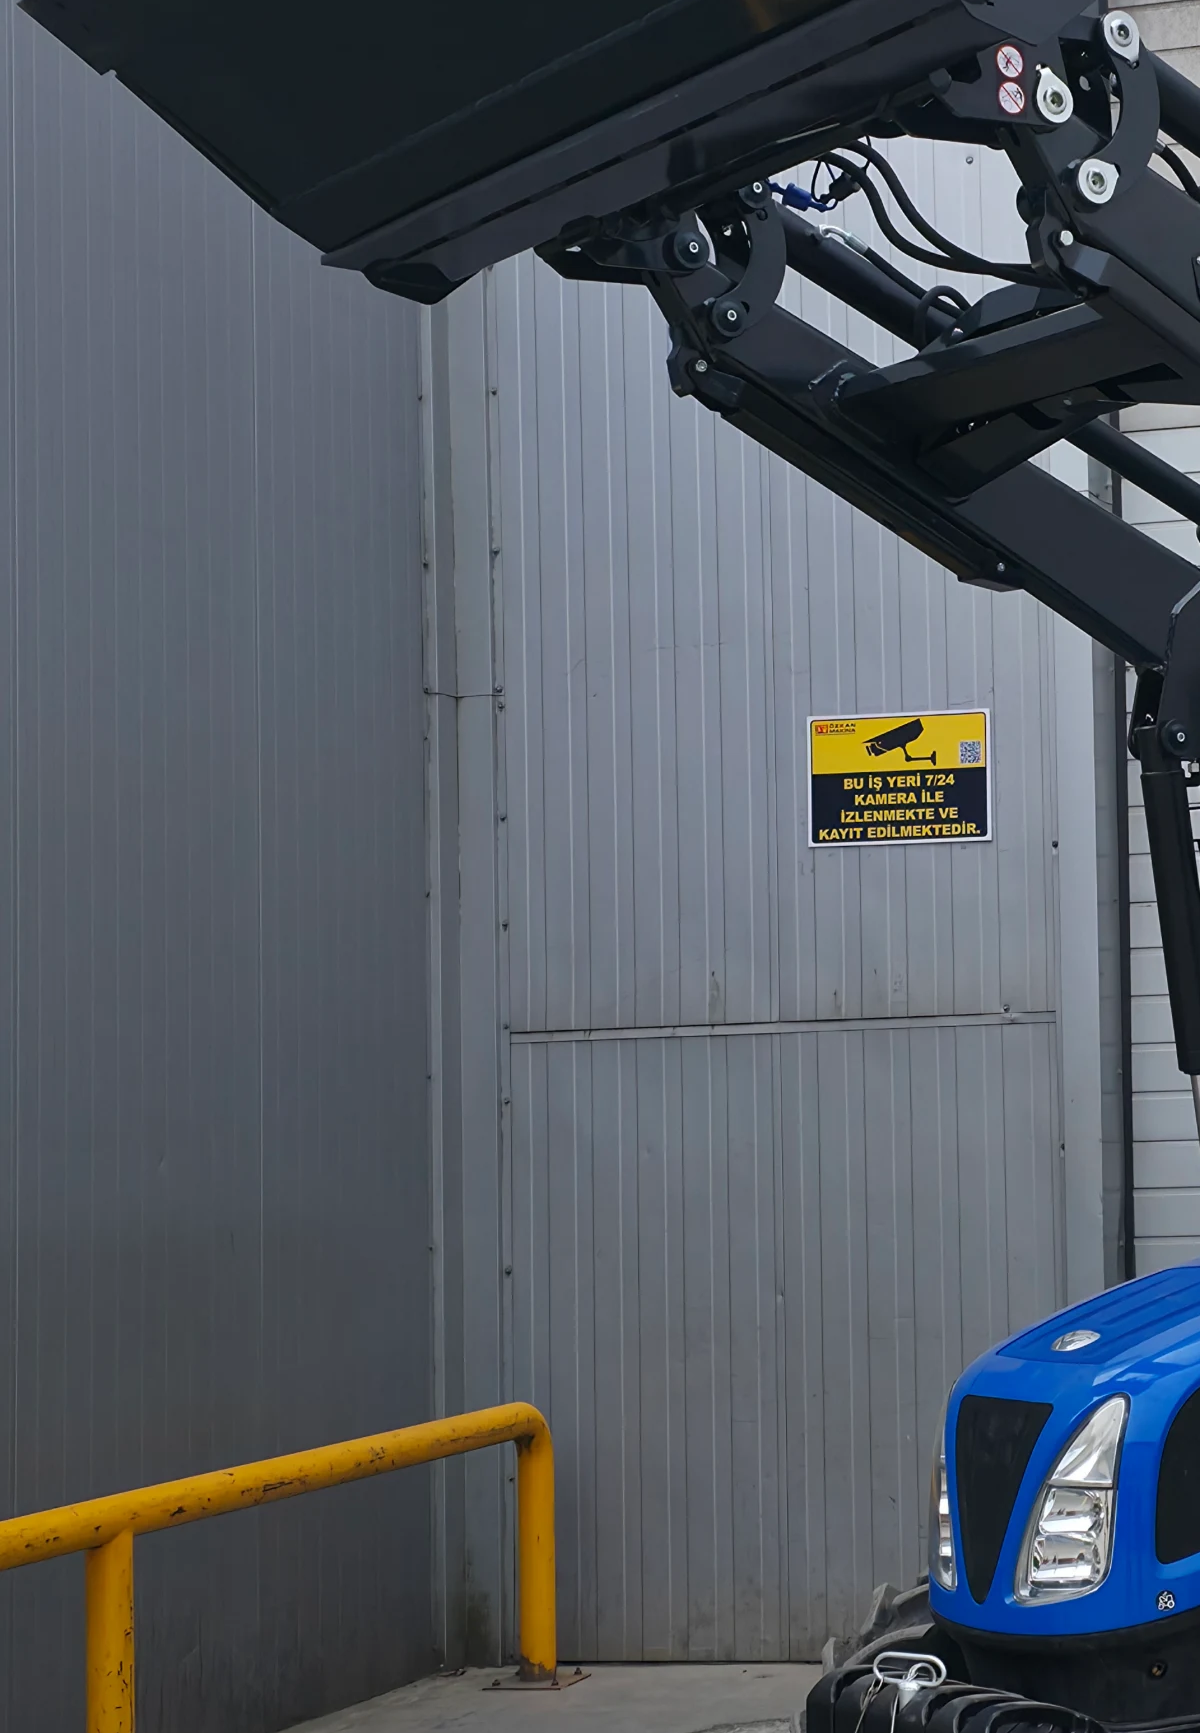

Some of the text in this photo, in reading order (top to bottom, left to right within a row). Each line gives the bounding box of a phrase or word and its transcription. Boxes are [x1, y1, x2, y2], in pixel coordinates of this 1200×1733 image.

[843, 773, 955, 791] BU İŞ YERİ 7/24
[854, 789, 944, 806] KAMERA İLE
[840, 807, 958, 823] İZLENMEKTE VE
[819, 821, 981, 840] KAYIT EDİLMEKTEDİR.
